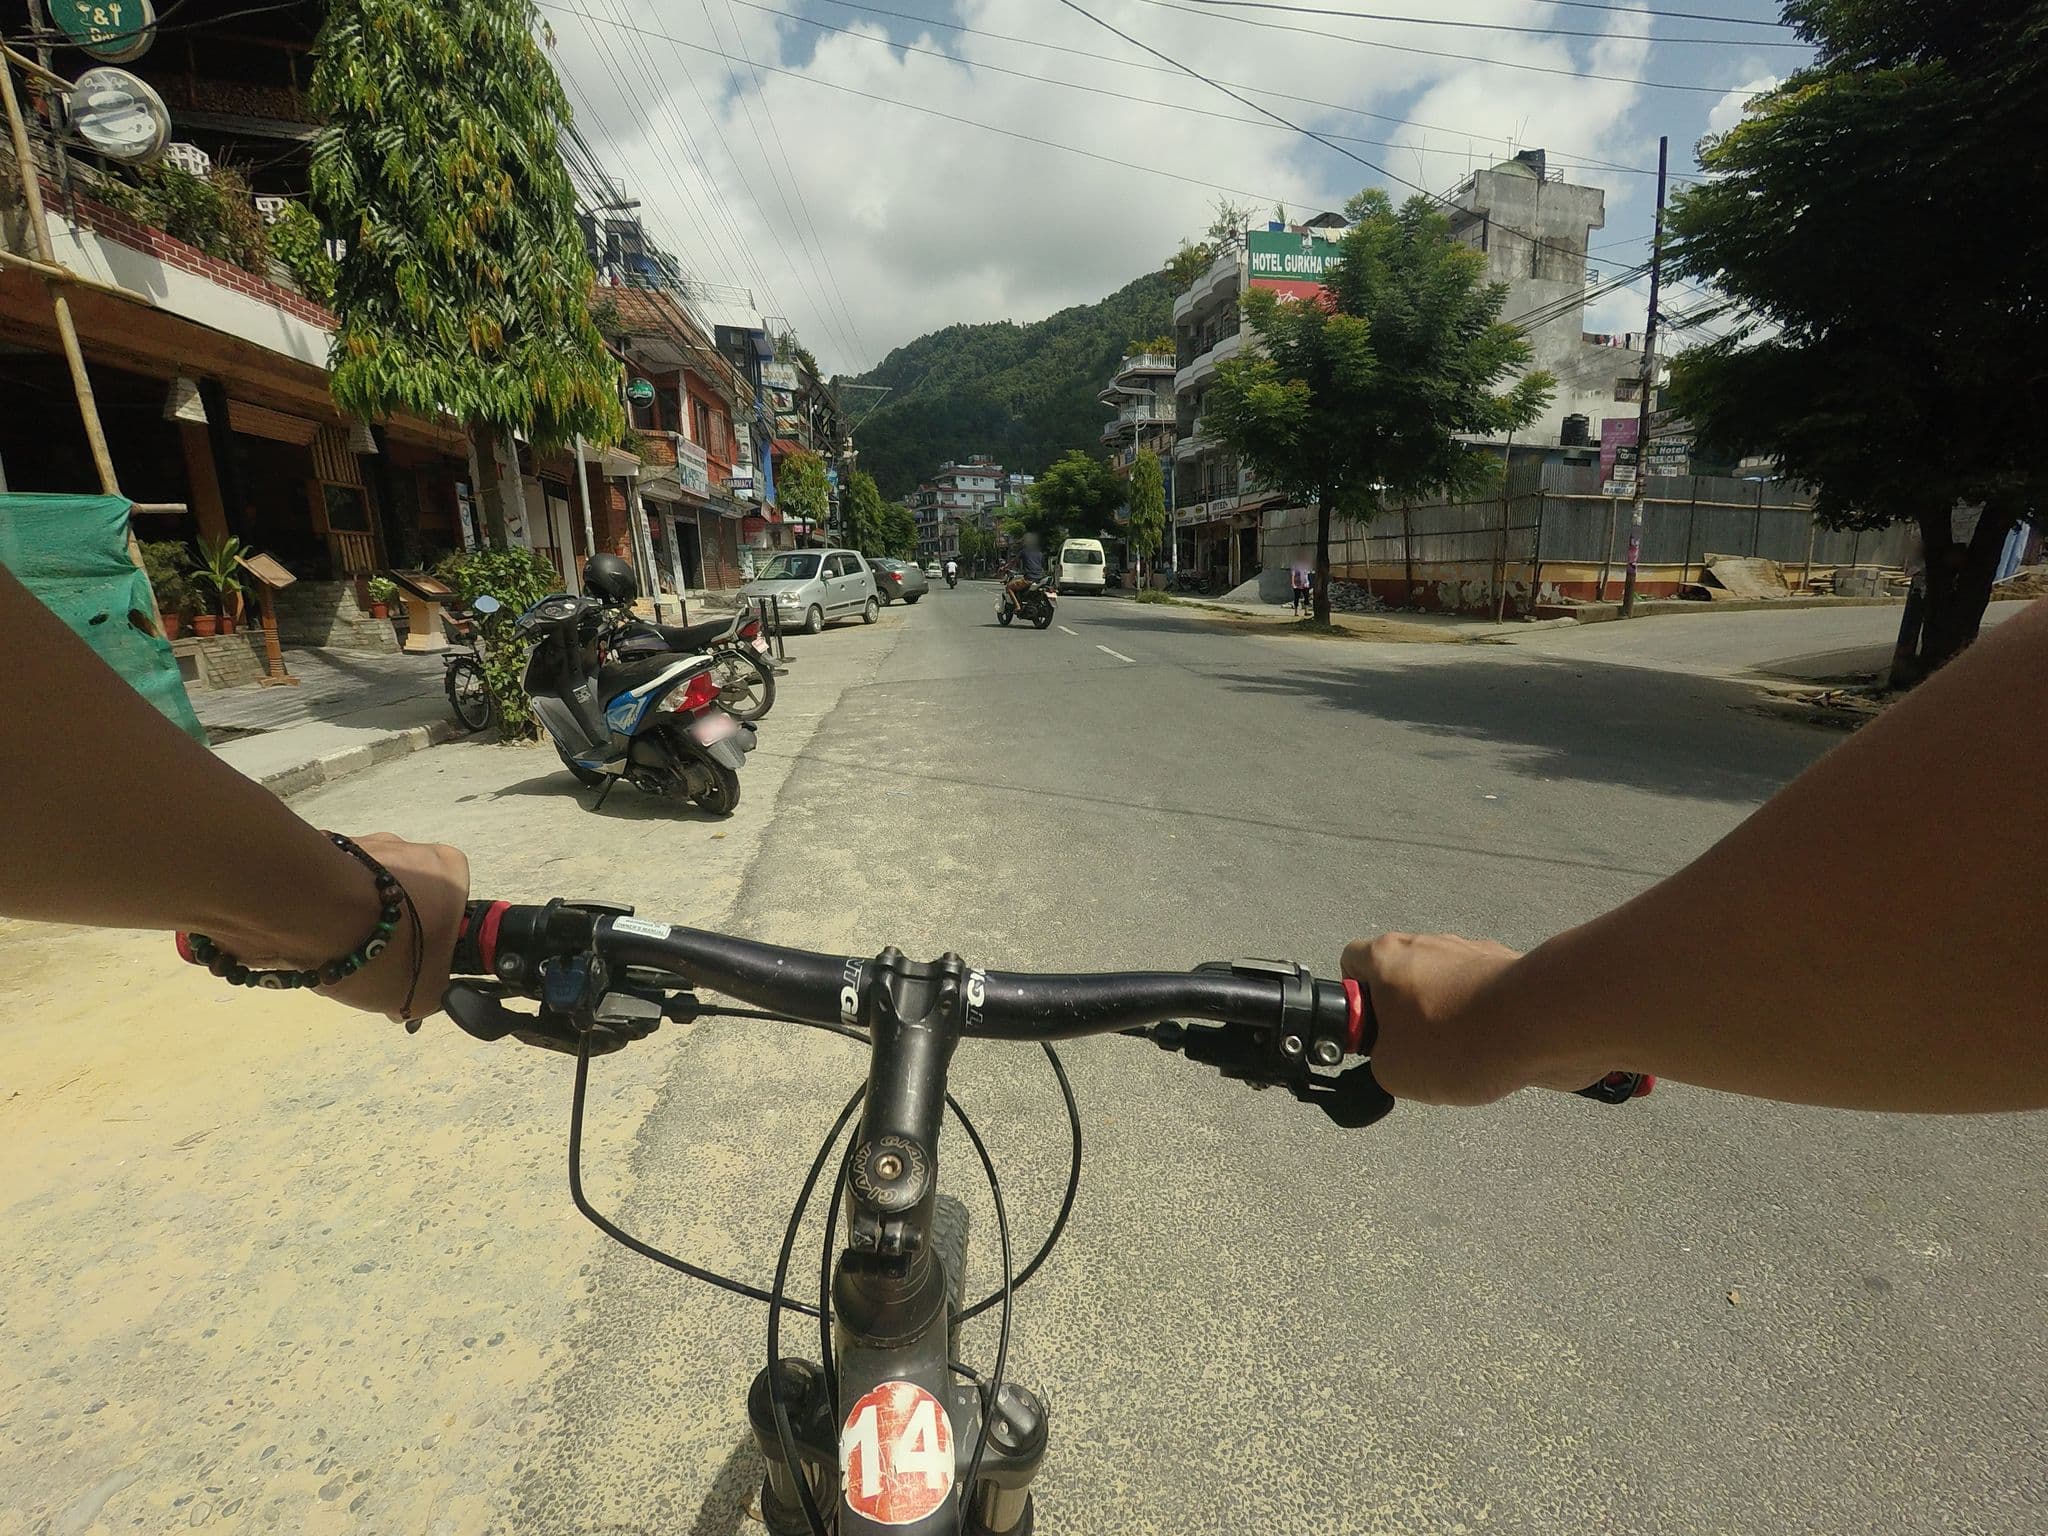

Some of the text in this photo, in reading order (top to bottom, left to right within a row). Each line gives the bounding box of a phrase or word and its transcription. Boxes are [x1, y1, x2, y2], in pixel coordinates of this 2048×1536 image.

[1252, 252, 1282, 272] HOTEL
[1284, 254, 1323, 274] GURKHA
[841, 1400, 950, 1498] 14
